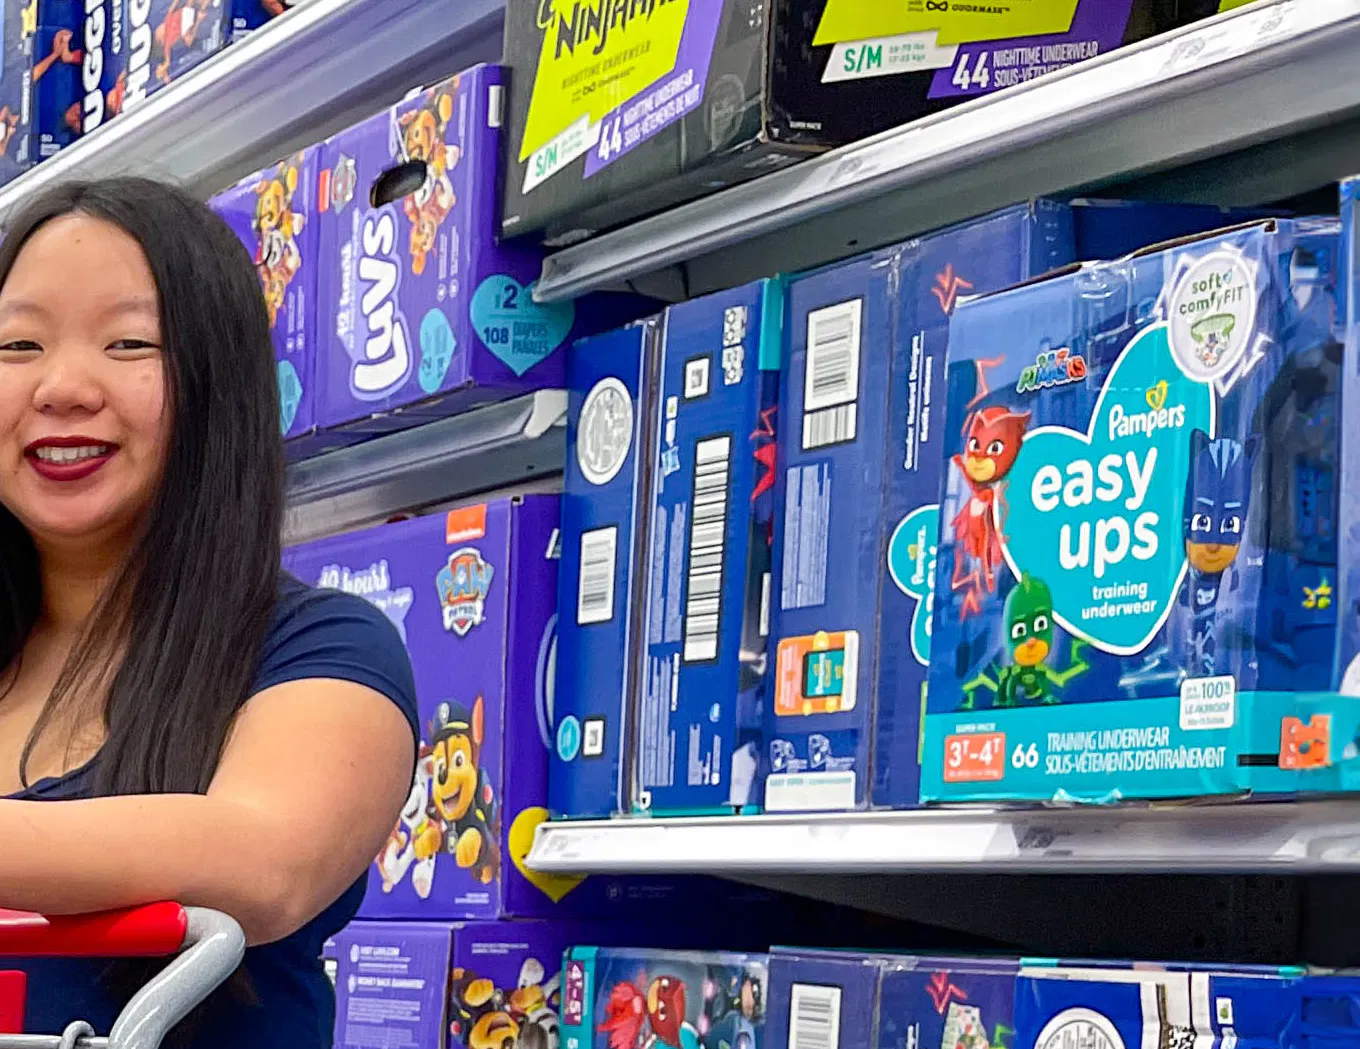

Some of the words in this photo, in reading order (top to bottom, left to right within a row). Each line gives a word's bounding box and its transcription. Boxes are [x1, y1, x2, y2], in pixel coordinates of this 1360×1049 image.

[844, 44, 882, 72] S/M
[993, 46, 1041, 66] NIGHTTIME
[952, 51, 990, 90] 44
[598, 113, 622, 160] 44
[1191, 273, 1222, 295] soft
[483, 326, 509, 344] 108
[1108, 402, 1185, 441] Pampers
[1031, 446, 1159, 512] easy
[1058, 510, 1159, 578] ups
[1092, 581, 1148, 602] training
[1081, 600, 1157, 621] underwear
[1047, 730, 1098, 752] TRAINING
[1099, 726, 1169, 749] UNDERWEAR
[1012, 743, 1039, 769] 66
